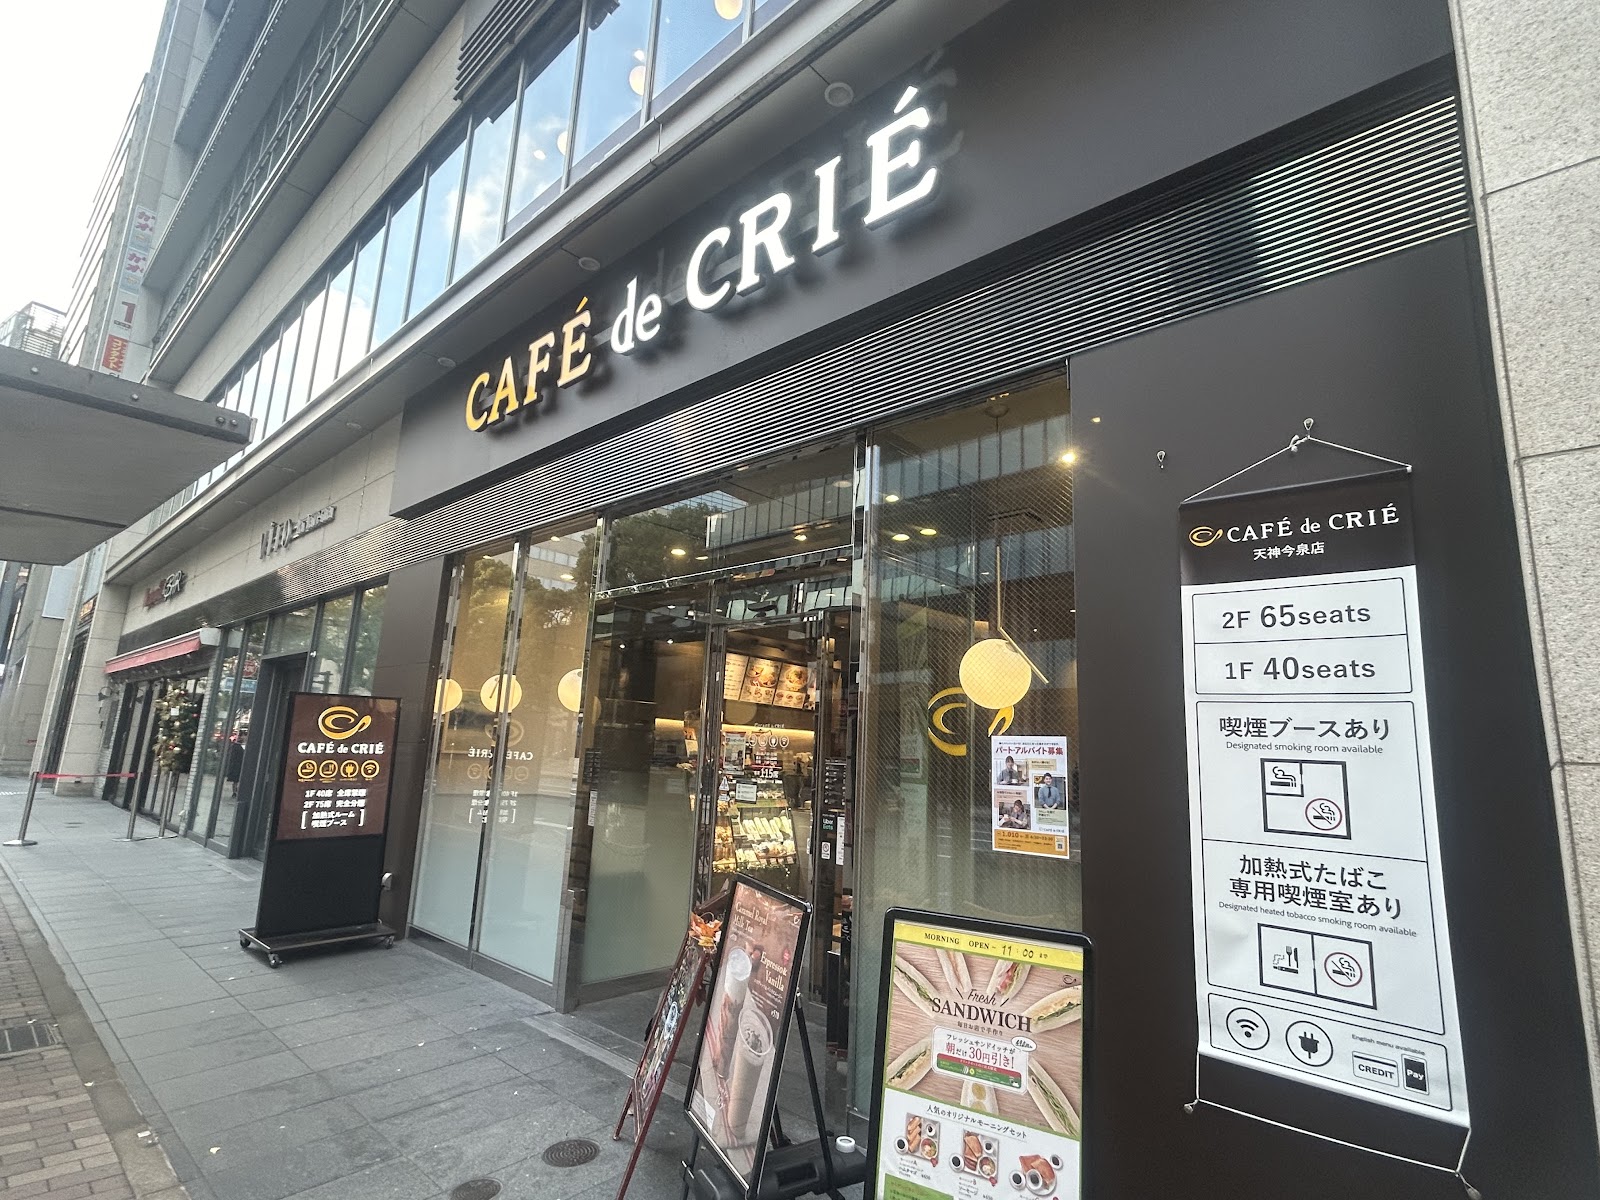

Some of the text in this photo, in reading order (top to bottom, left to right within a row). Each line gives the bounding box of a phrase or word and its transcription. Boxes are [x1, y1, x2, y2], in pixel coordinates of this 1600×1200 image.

[465, 86, 938, 432] CAFÉ de CRIÉ
[1227, 503, 1400, 543] CAFÉ de CRIÉ
[1253, 541, 1325, 561] 天神今泉店
[1222, 604, 1371, 629] 2F 65seats
[1225, 656, 1376, 680] 1F 40seats
[1219, 716, 1390, 741] 喫煙ブースあり
[297, 741, 385, 755] CAFÉ de CRIÉ
[1226, 741, 1383, 754] Designated smoking room available
[1239, 855, 1387, 890] 加熱式たばこ
[1229, 878, 1402, 920] 専用喫煙室あり
[1218, 901, 1417, 938] Designated heated tobacco smoking room available
[924, 932, 960, 945] MORNING
[968, 940, 990, 949] OPEN
[765, 968, 785, 992] Vanilla
[967, 988, 998, 1007] Fresh
[931, 997, 1033, 1033] SANDWICH
[946, 1033, 1016, 1055] フレッシュサンドイッチが
[1358, 1063, 1395, 1079] CREDIT
[1406, 1068, 1424, 1081] Pay
[926, 1104, 1028, 1140] 人気のオリジナルモーニングセット
